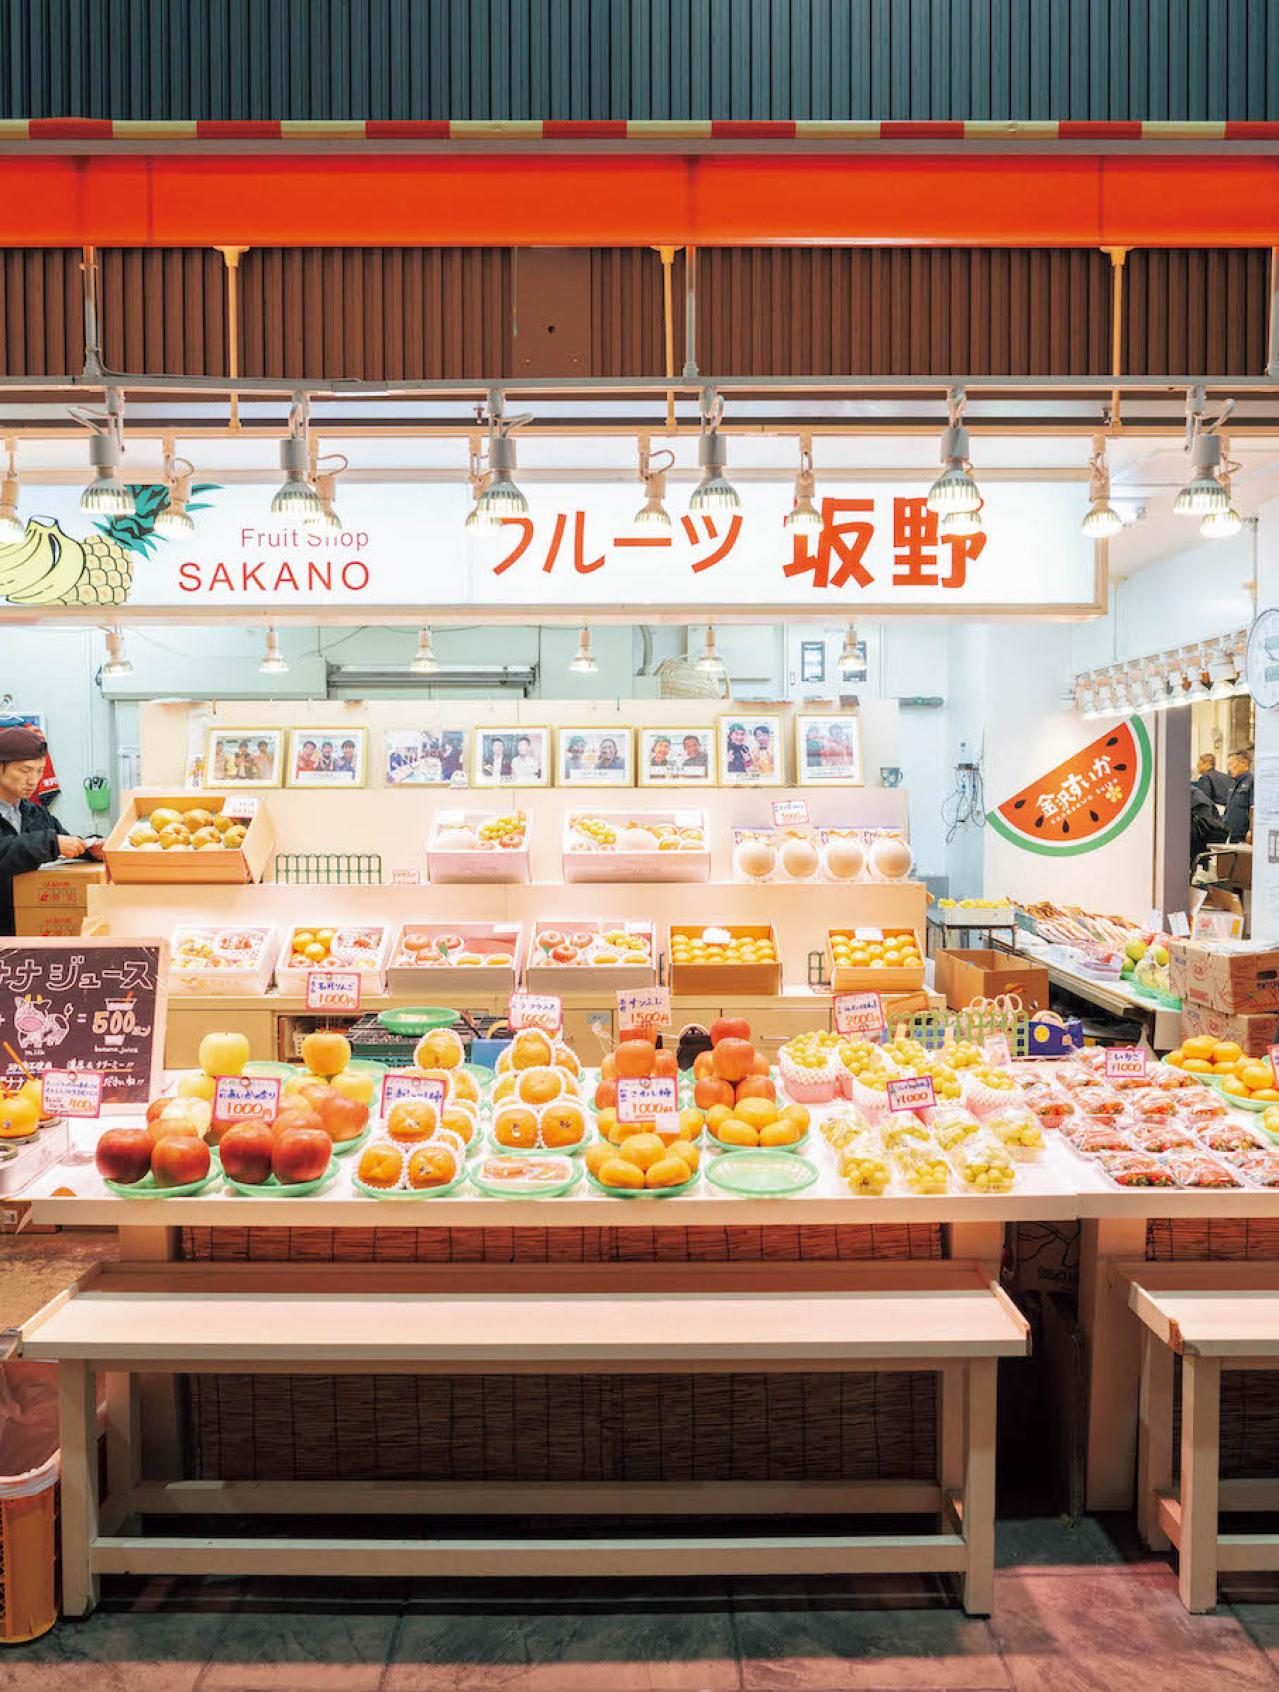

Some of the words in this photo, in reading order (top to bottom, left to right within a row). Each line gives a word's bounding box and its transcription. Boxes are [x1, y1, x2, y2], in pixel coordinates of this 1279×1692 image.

[241, 528, 299, 548] Fruit
[492, 510, 744, 576] フルーツ
[782, 496, 988, 589] 坂野
[178, 560, 370, 592] SAKANO
[1036, 754, 1111, 818] 金沢すいか
[226, 1102, 273, 1118] 1000円
